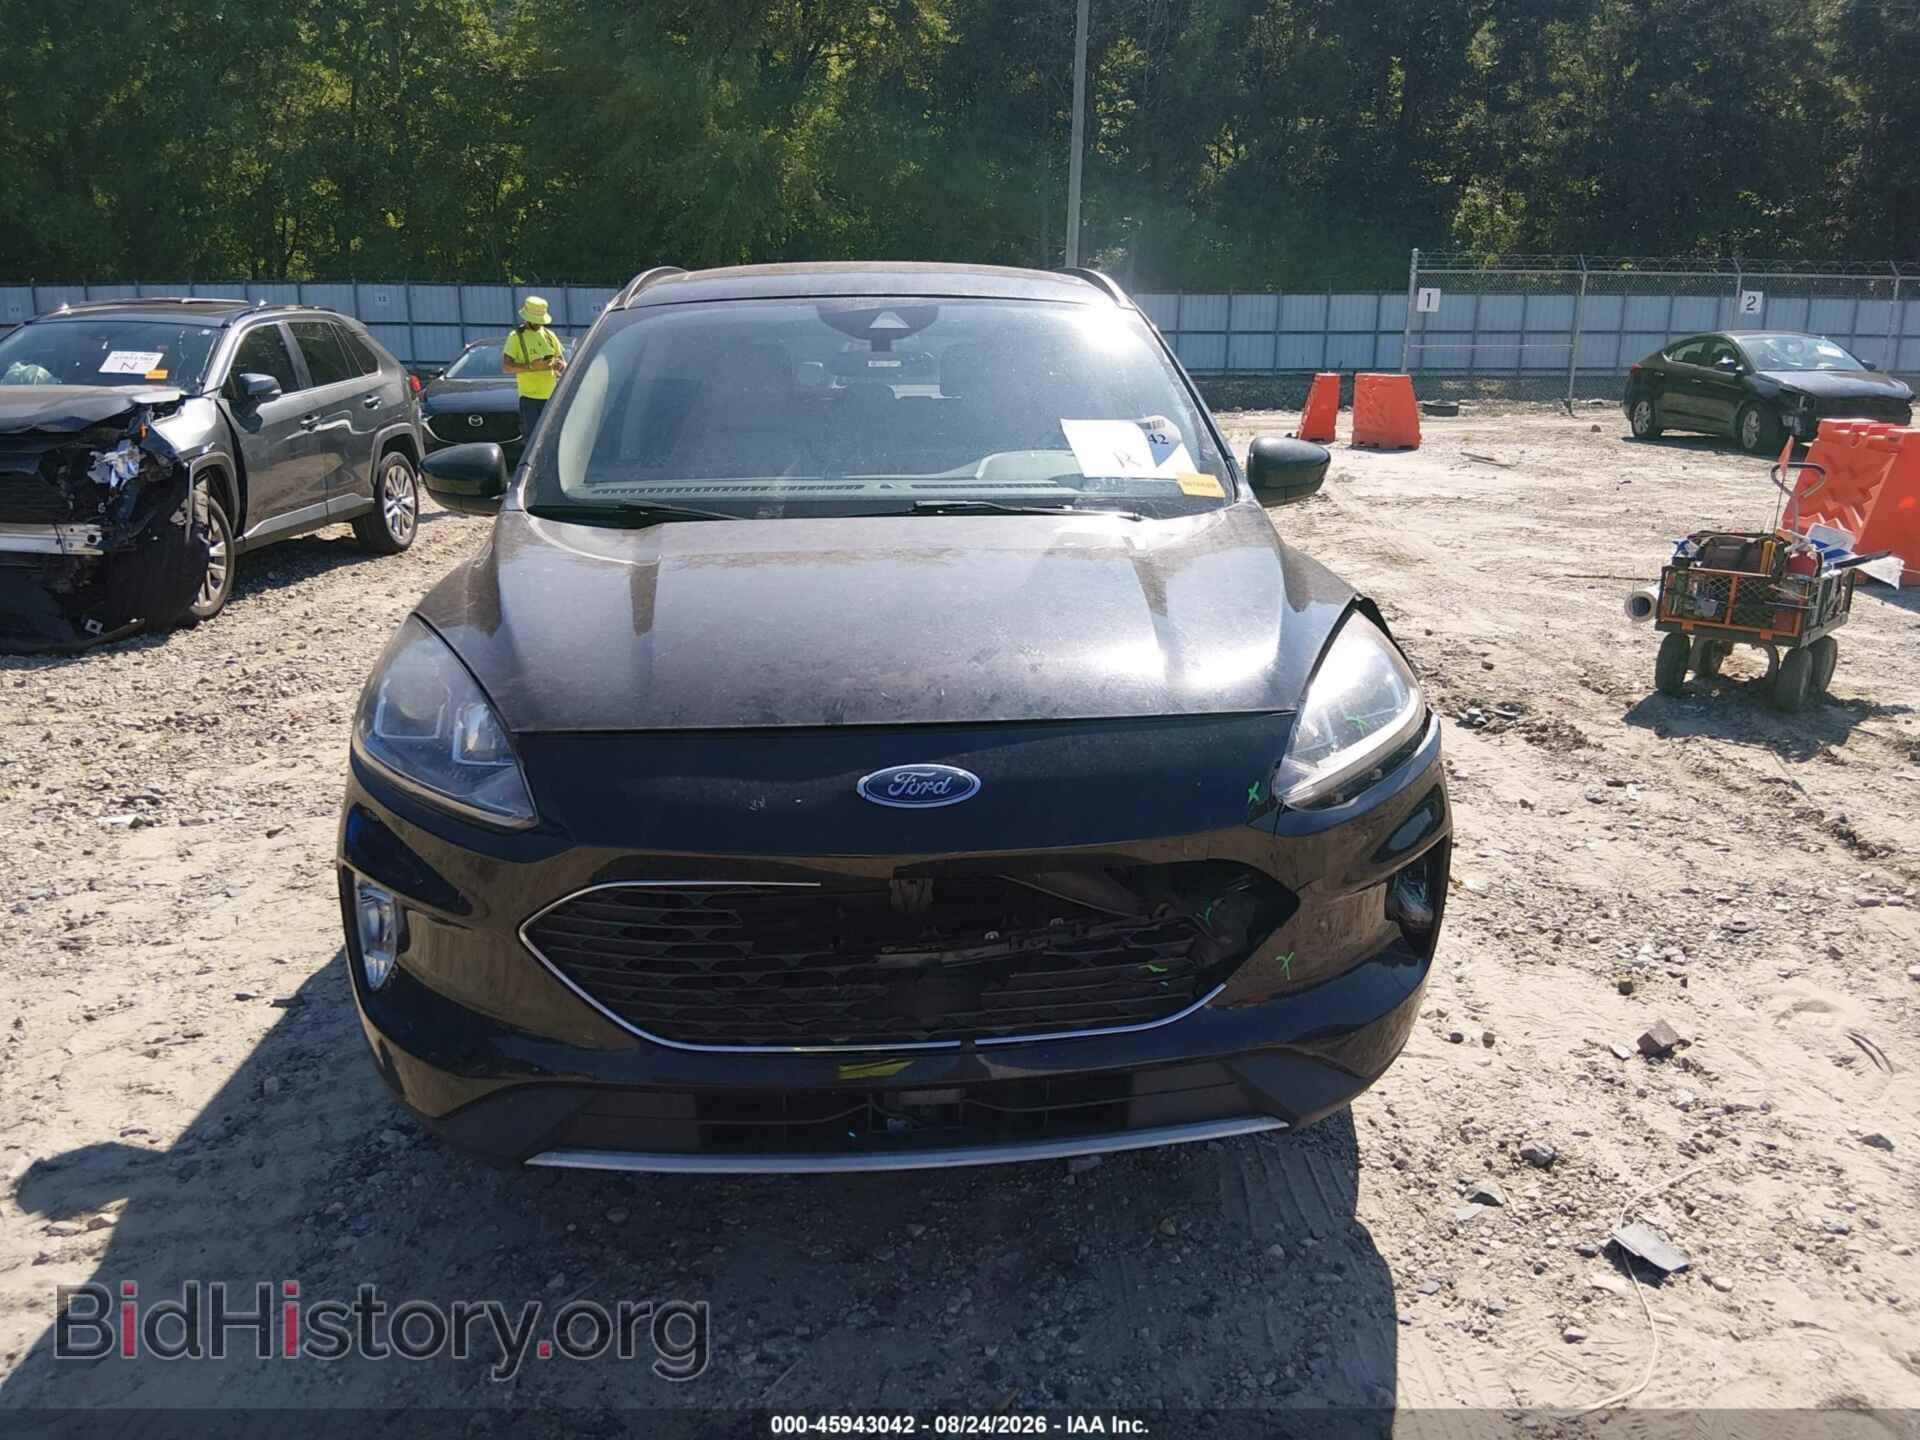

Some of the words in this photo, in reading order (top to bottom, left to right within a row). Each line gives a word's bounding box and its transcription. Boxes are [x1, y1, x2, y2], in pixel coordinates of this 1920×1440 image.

[1426, 292, 1432, 309] 1
[1745, 295, 1757, 311] 2
[887, 771, 953, 796] Ford
